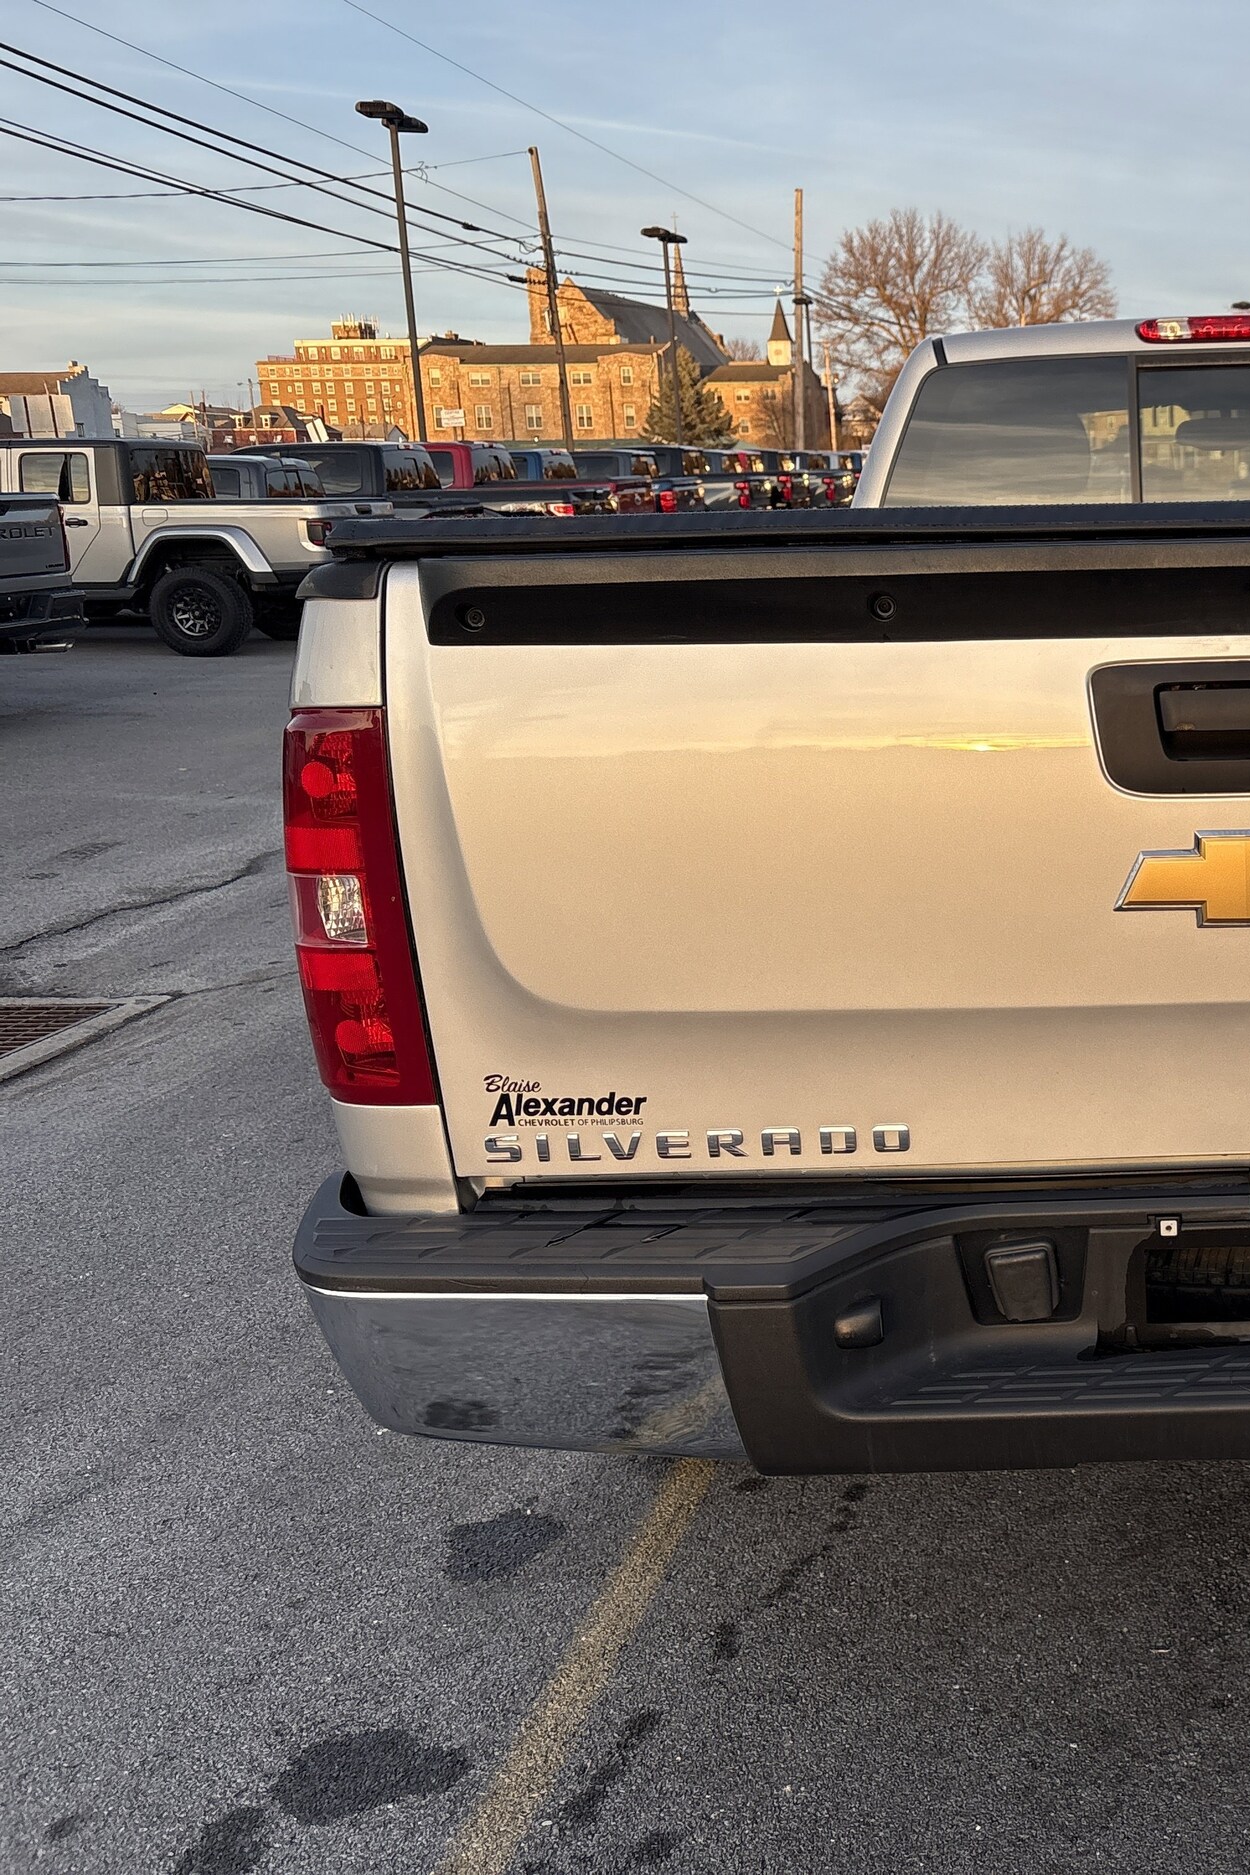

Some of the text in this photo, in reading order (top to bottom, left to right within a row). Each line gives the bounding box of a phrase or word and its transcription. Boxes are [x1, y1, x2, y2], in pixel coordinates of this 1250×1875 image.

[483, 1074, 541, 1092] Blaise
[489, 1092, 647, 1127] Alexander
[518, 1118, 644, 1127] CHEVROLET OF PHILIPSBURG
[484, 1123, 911, 1163] SILVERADO
